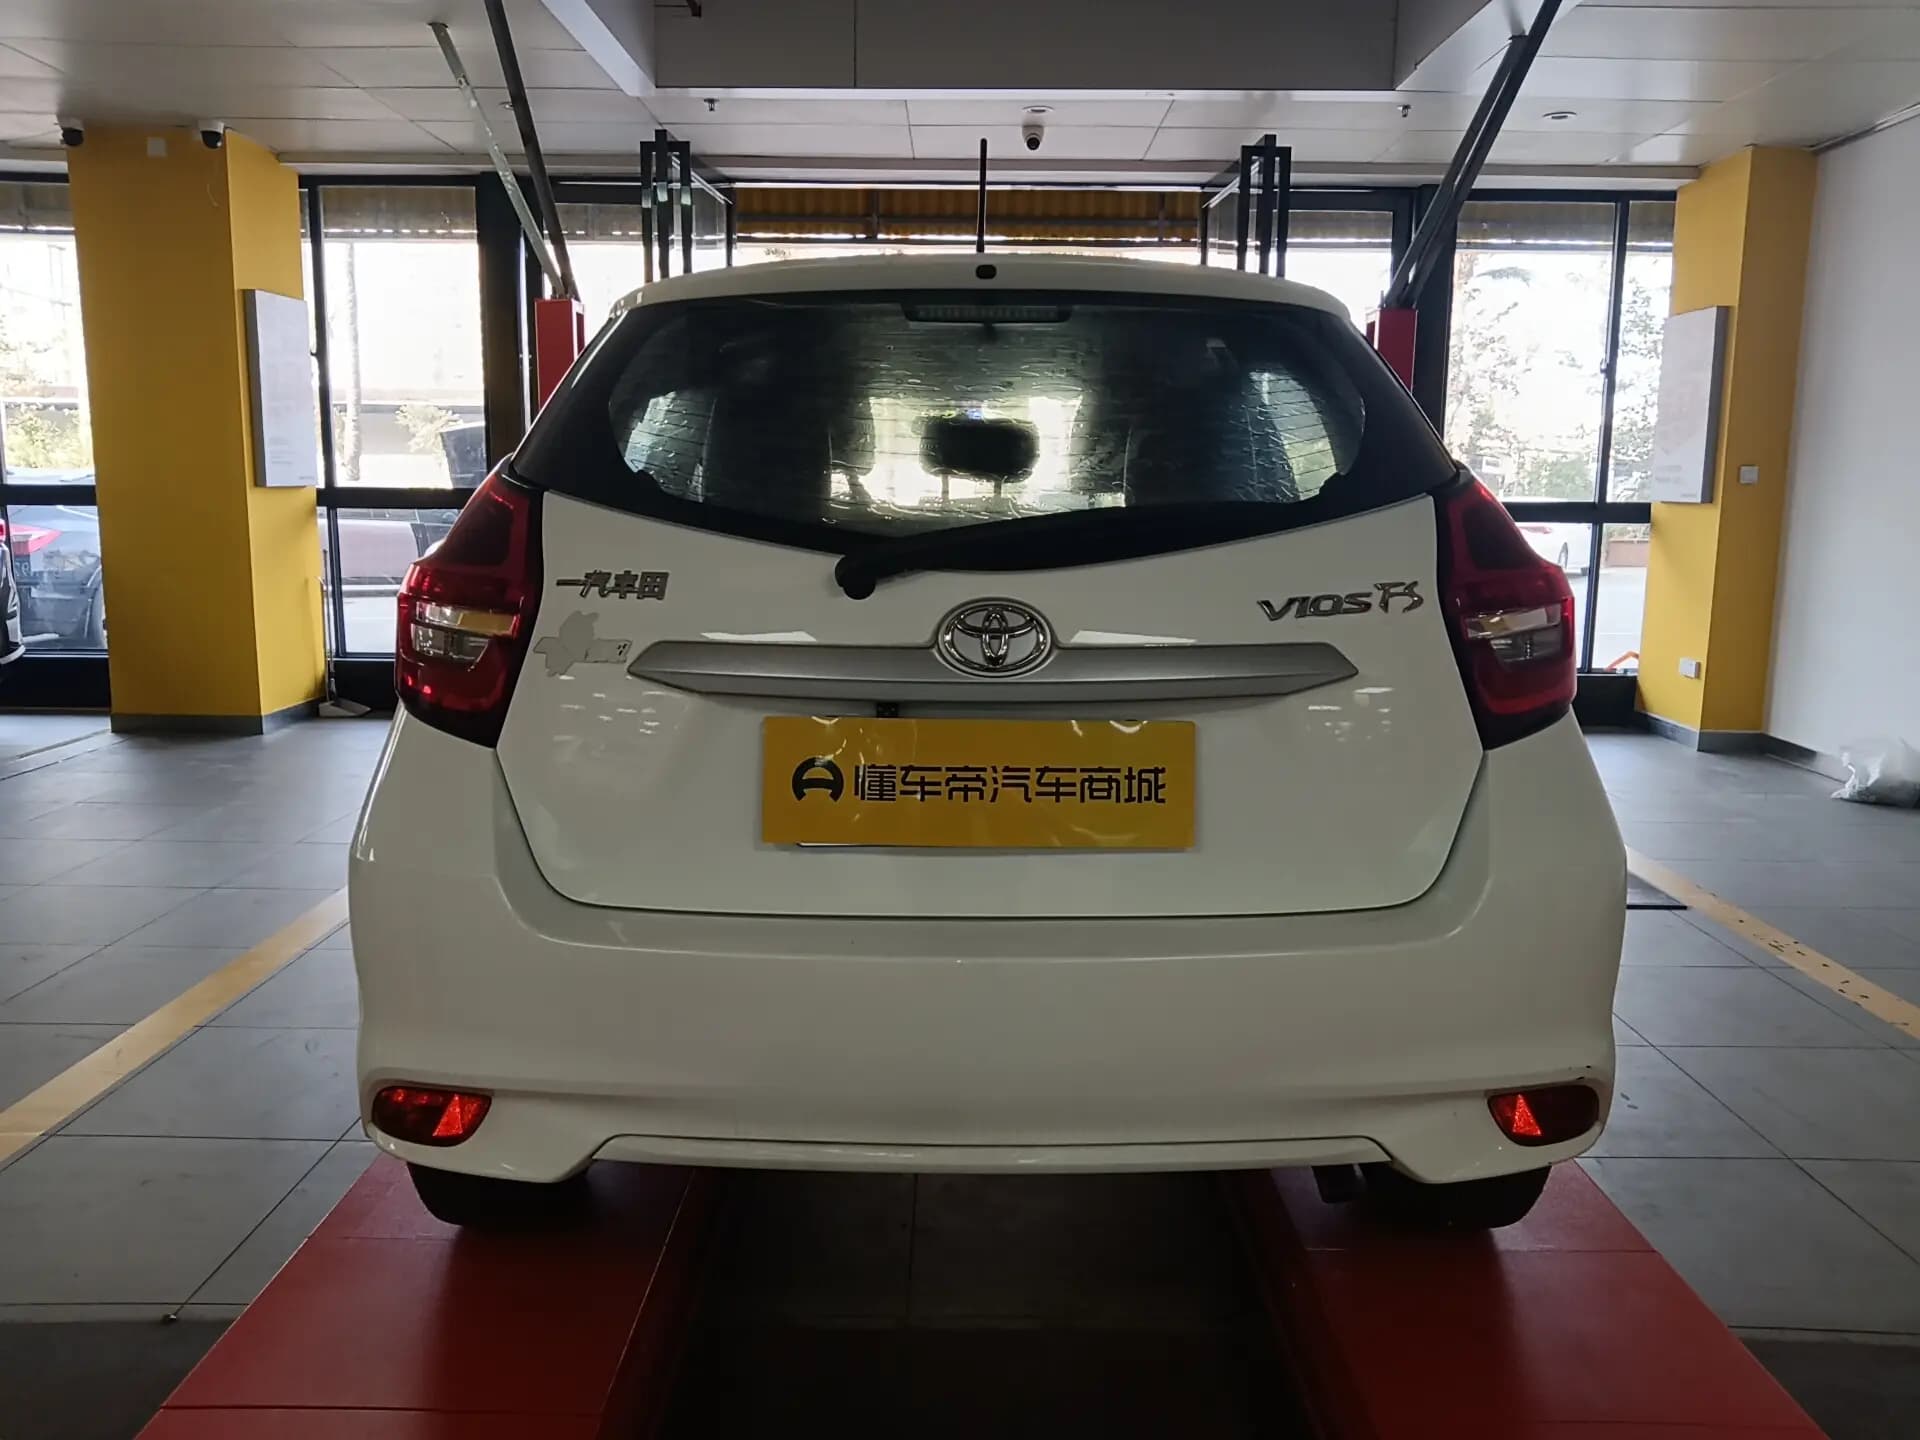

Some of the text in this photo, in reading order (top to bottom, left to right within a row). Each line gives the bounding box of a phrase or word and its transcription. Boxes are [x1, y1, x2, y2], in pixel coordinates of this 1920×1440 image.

[1257, 592, 1373, 621] VIOS
[853, 764, 1167, 804] 懂车帝汽车商城
